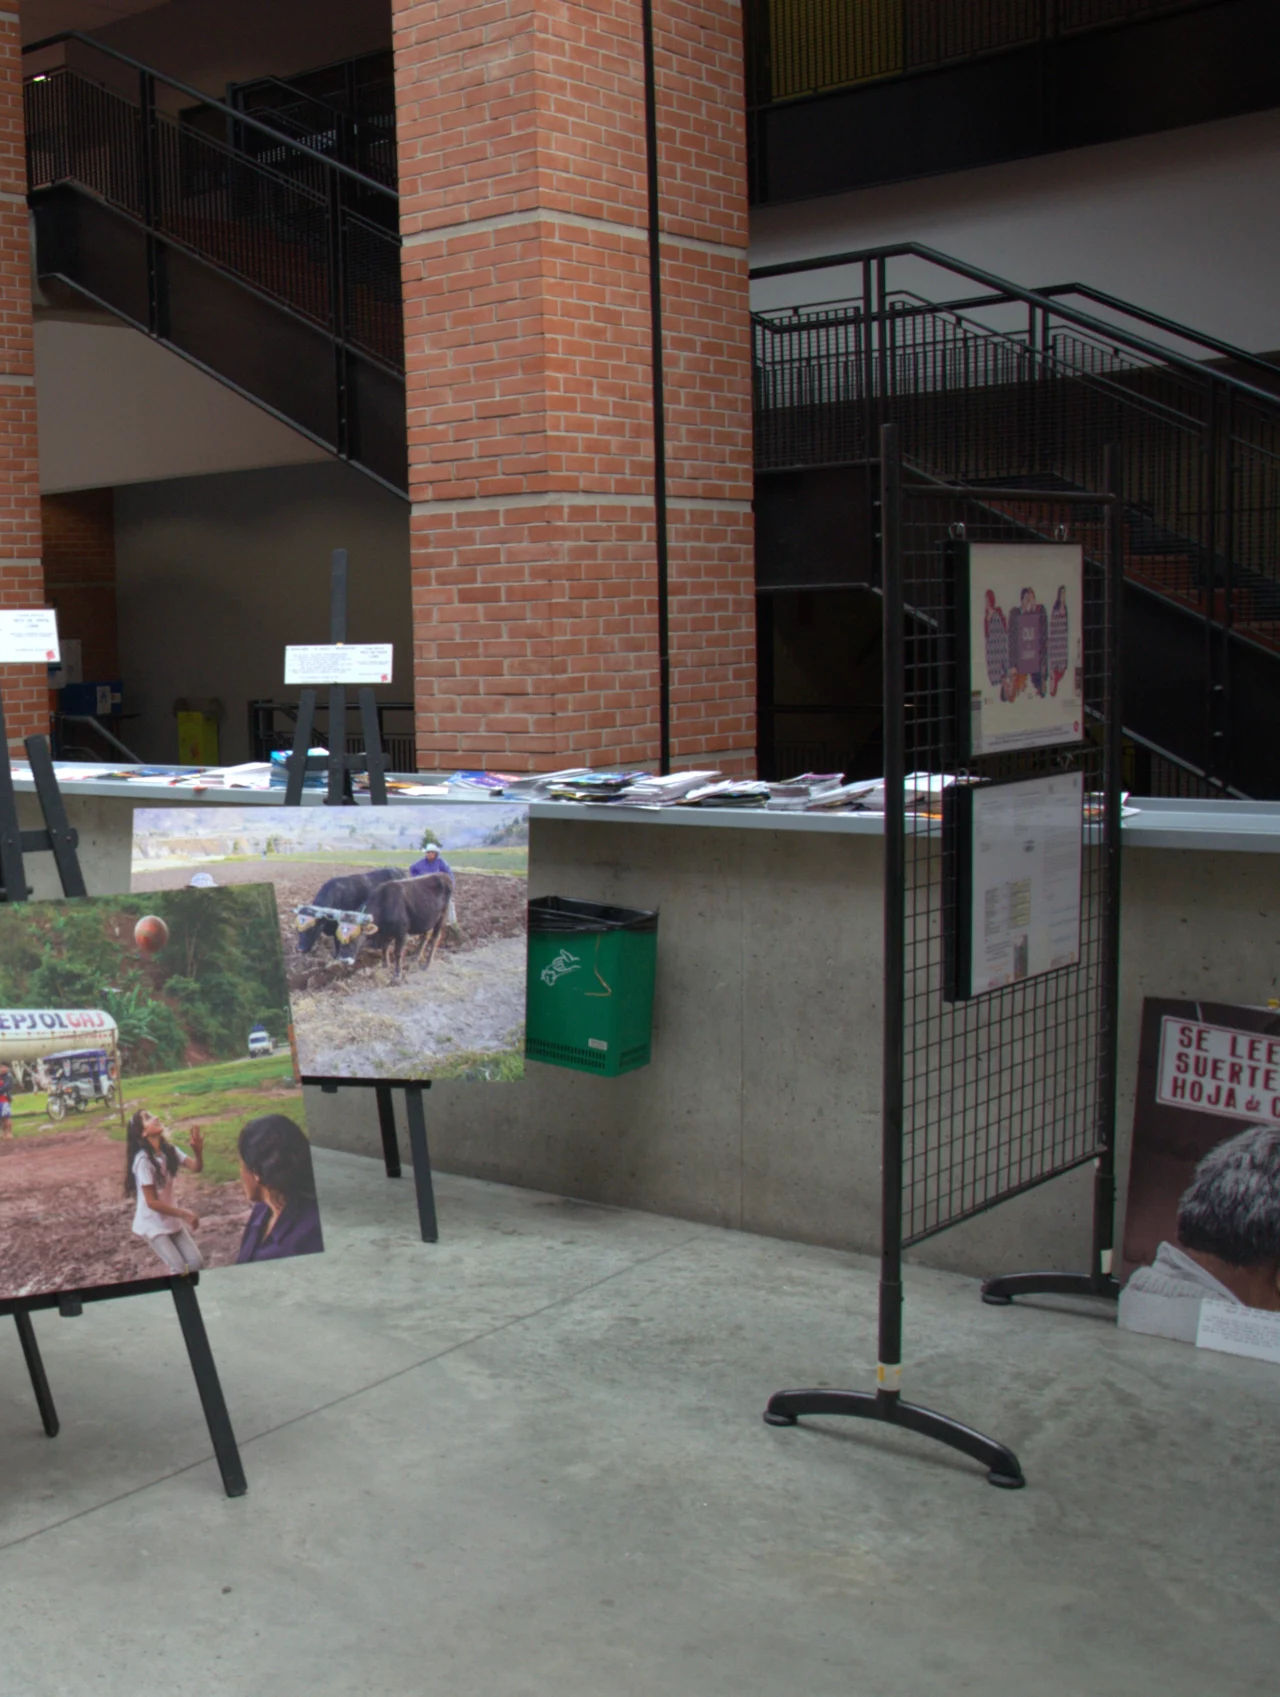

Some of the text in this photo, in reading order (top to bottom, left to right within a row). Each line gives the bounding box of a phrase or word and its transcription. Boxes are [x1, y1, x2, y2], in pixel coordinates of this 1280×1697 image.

[1178, 1025, 1211, 1053] SE
[1175, 1051, 1278, 1092] SUERTE
[1171, 1075, 1237, 1110] HOJA
[1243, 1093, 1262, 1113] de
